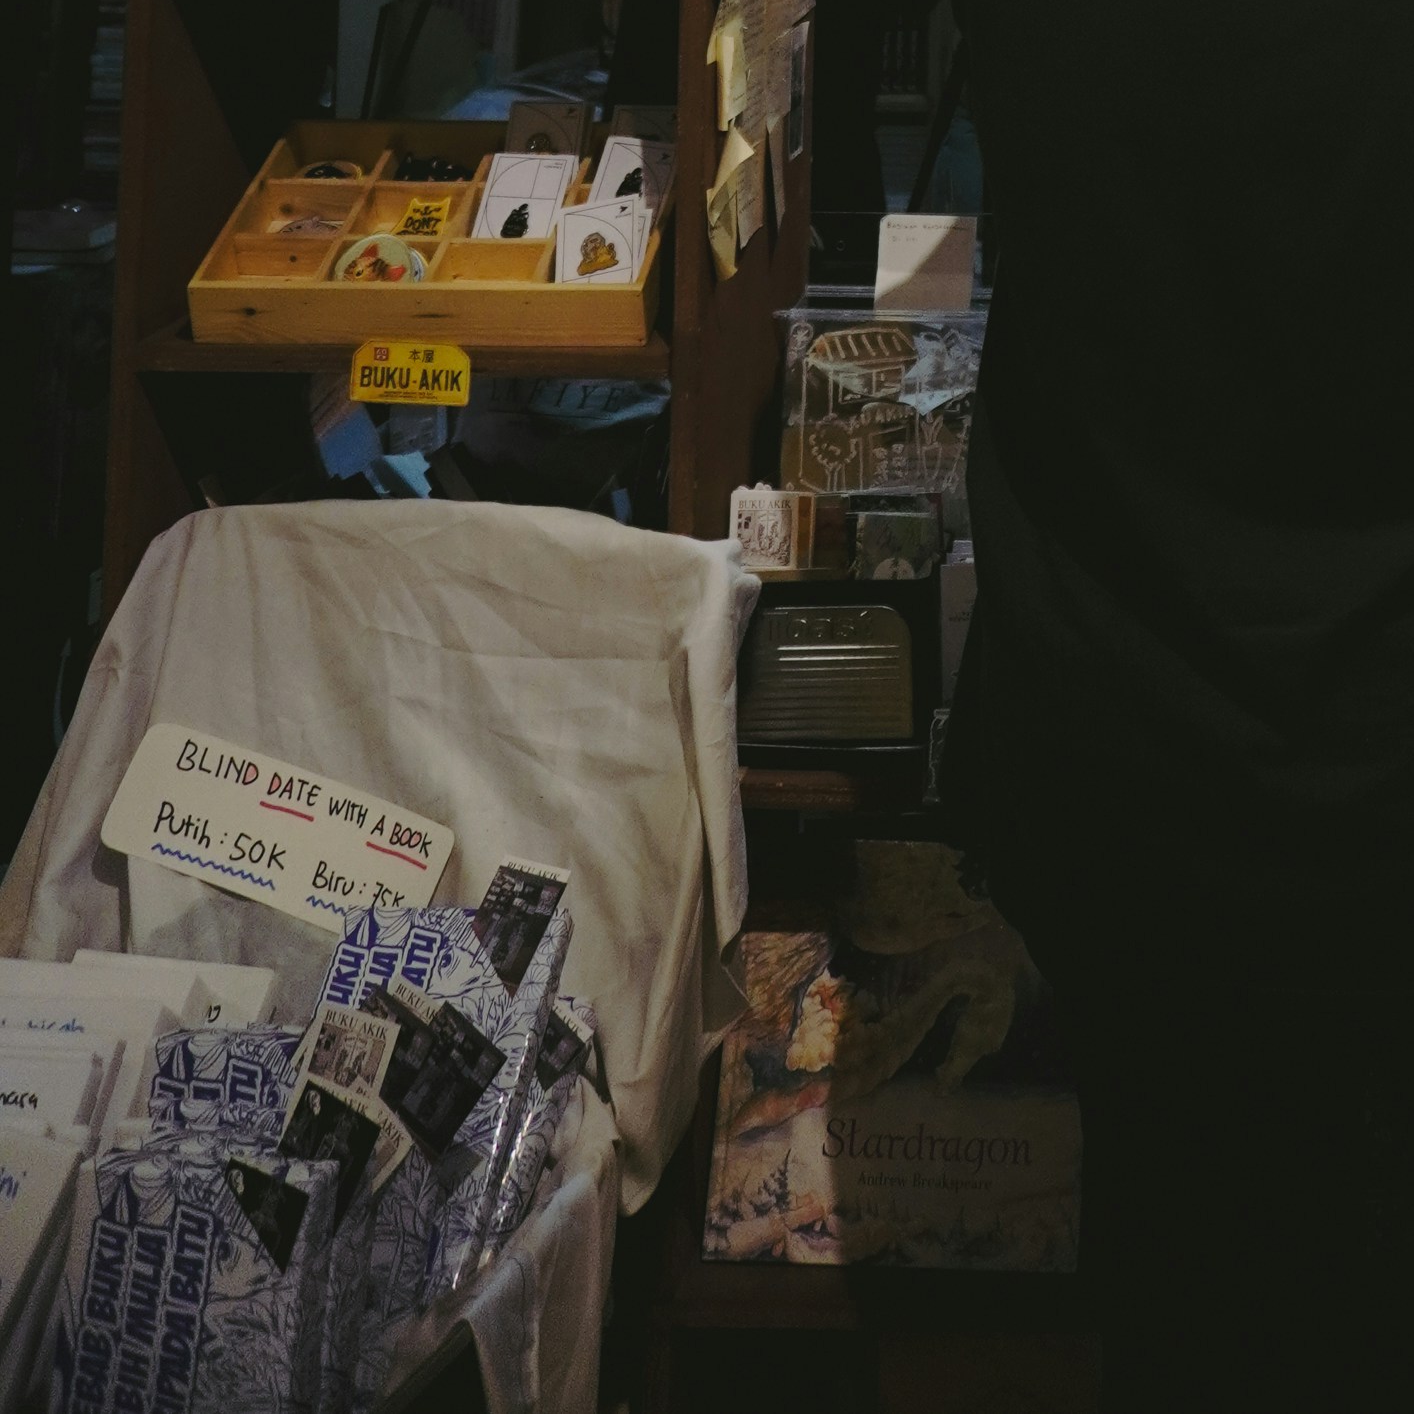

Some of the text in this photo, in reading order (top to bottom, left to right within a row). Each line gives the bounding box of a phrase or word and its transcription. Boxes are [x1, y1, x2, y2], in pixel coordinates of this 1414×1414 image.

[737, 498, 794, 511] BUKU AKIK
[176, 739, 434, 859] BLIND DATE WITH A BOOK
[153, 800, 287, 871] Putih 50K
[820, 1116, 1035, 1175] Stardragon
[857, 1171, 993, 1193] Andrew Breakspeare
